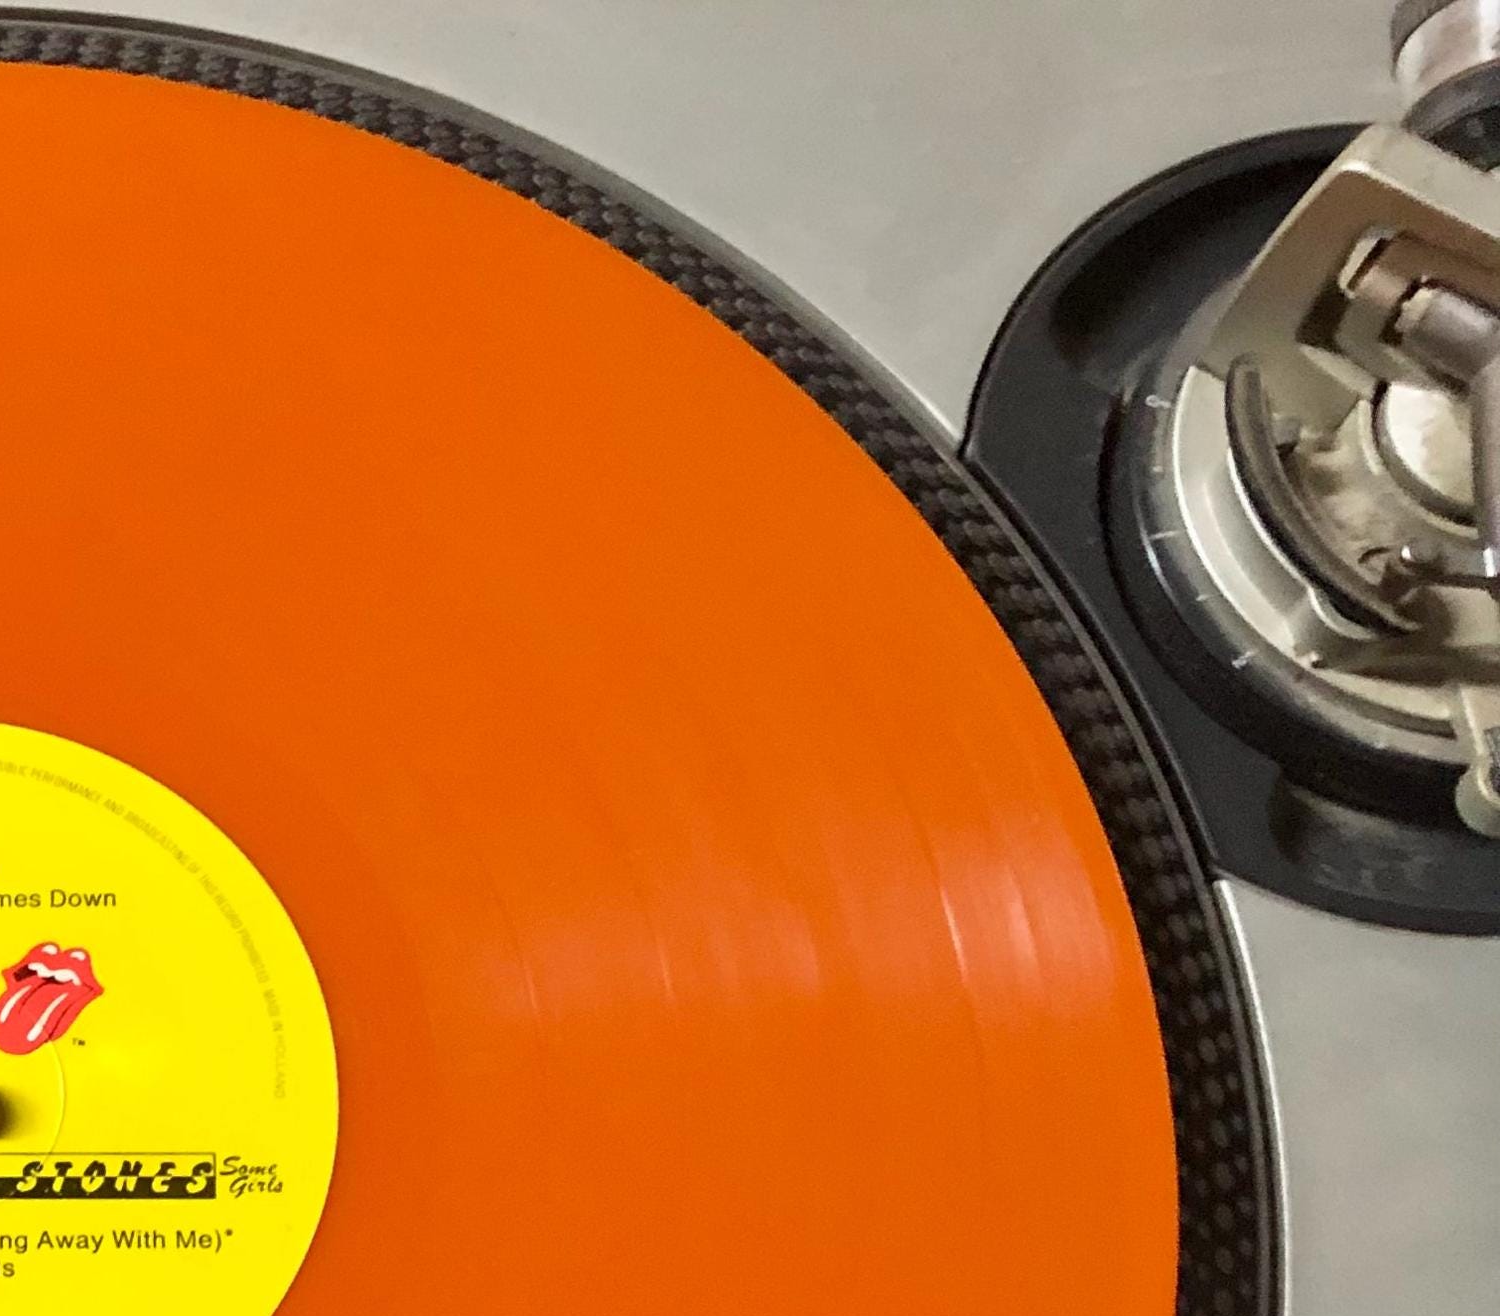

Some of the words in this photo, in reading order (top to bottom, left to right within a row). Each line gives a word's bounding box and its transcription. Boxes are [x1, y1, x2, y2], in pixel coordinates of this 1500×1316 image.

[49, 888, 117, 909] Down
[15, 1160, 214, 1194] STONES
[219, 1155, 277, 1176] Some
[229, 1175, 284, 1198] Girls
[36, 1230, 105, 1255] Away
[111, 1229, 167, 1250] With
